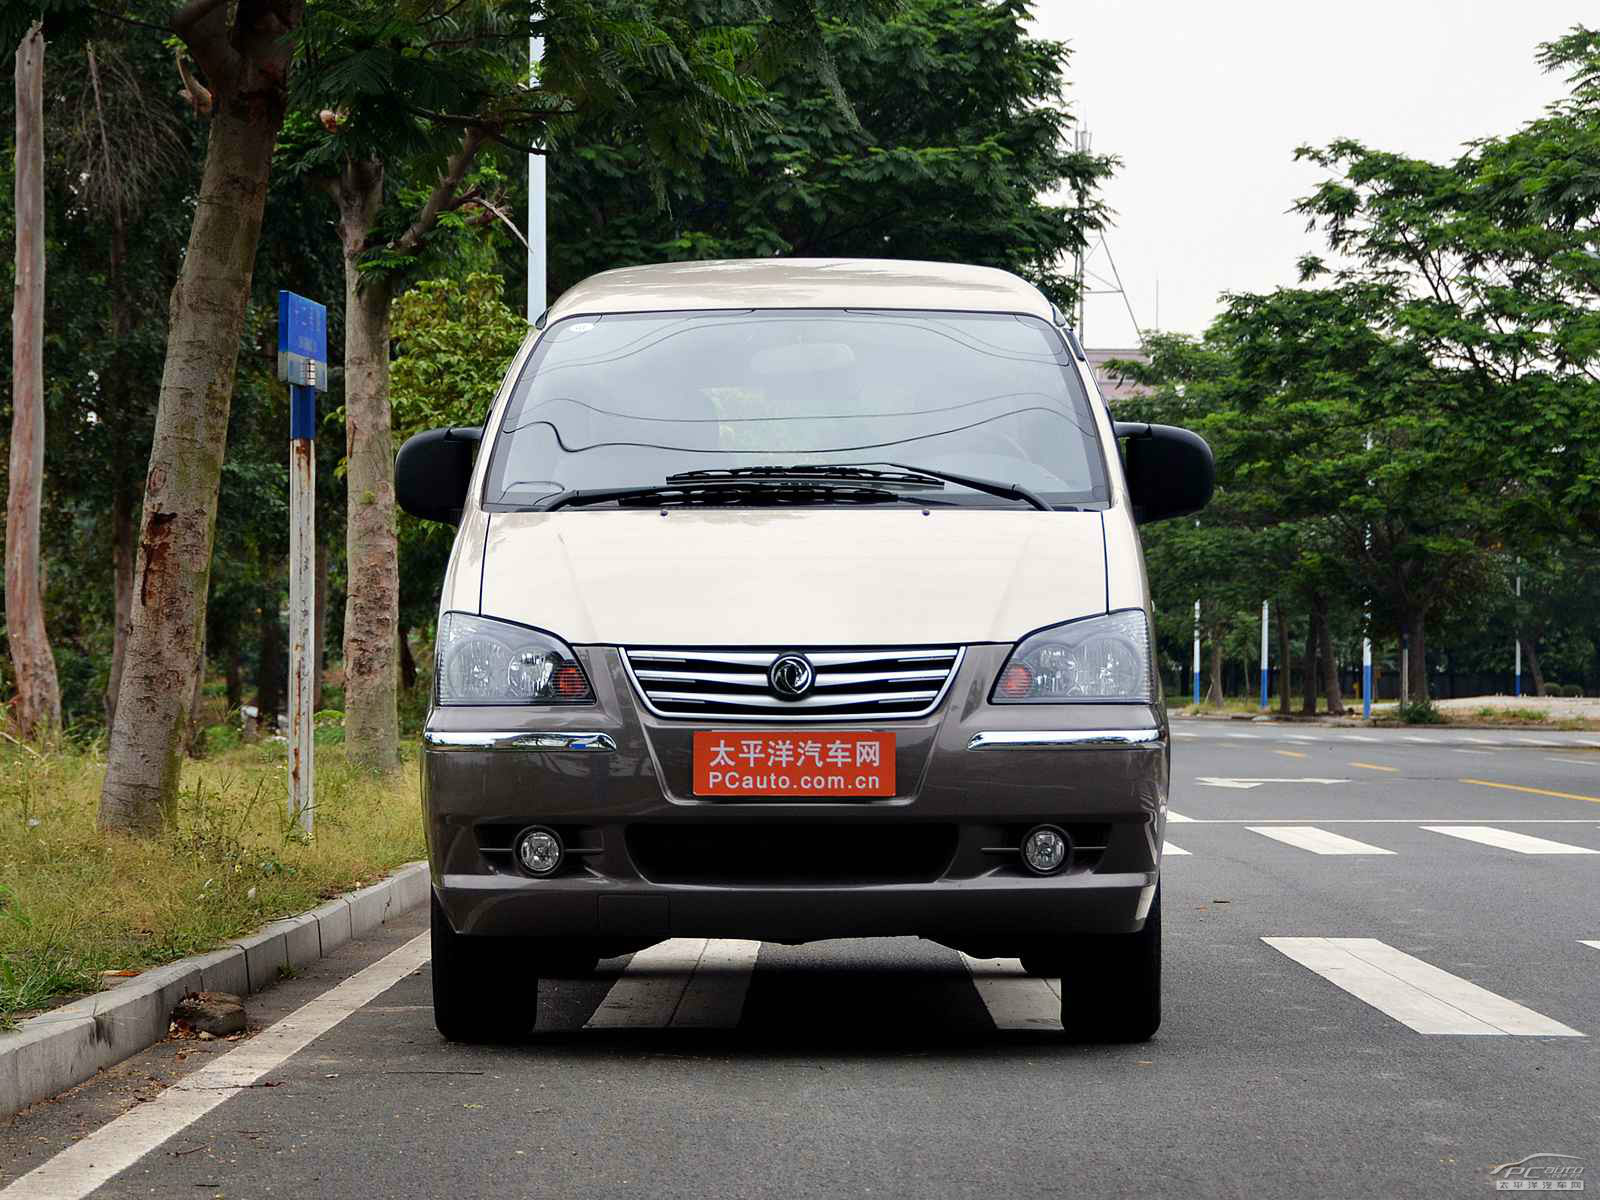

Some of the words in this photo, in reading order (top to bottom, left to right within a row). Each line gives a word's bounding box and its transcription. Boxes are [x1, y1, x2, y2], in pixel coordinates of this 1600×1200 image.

[709, 740, 880, 767] 太平洋汽车网
[709, 772, 879, 789] PCauto.com.cn
